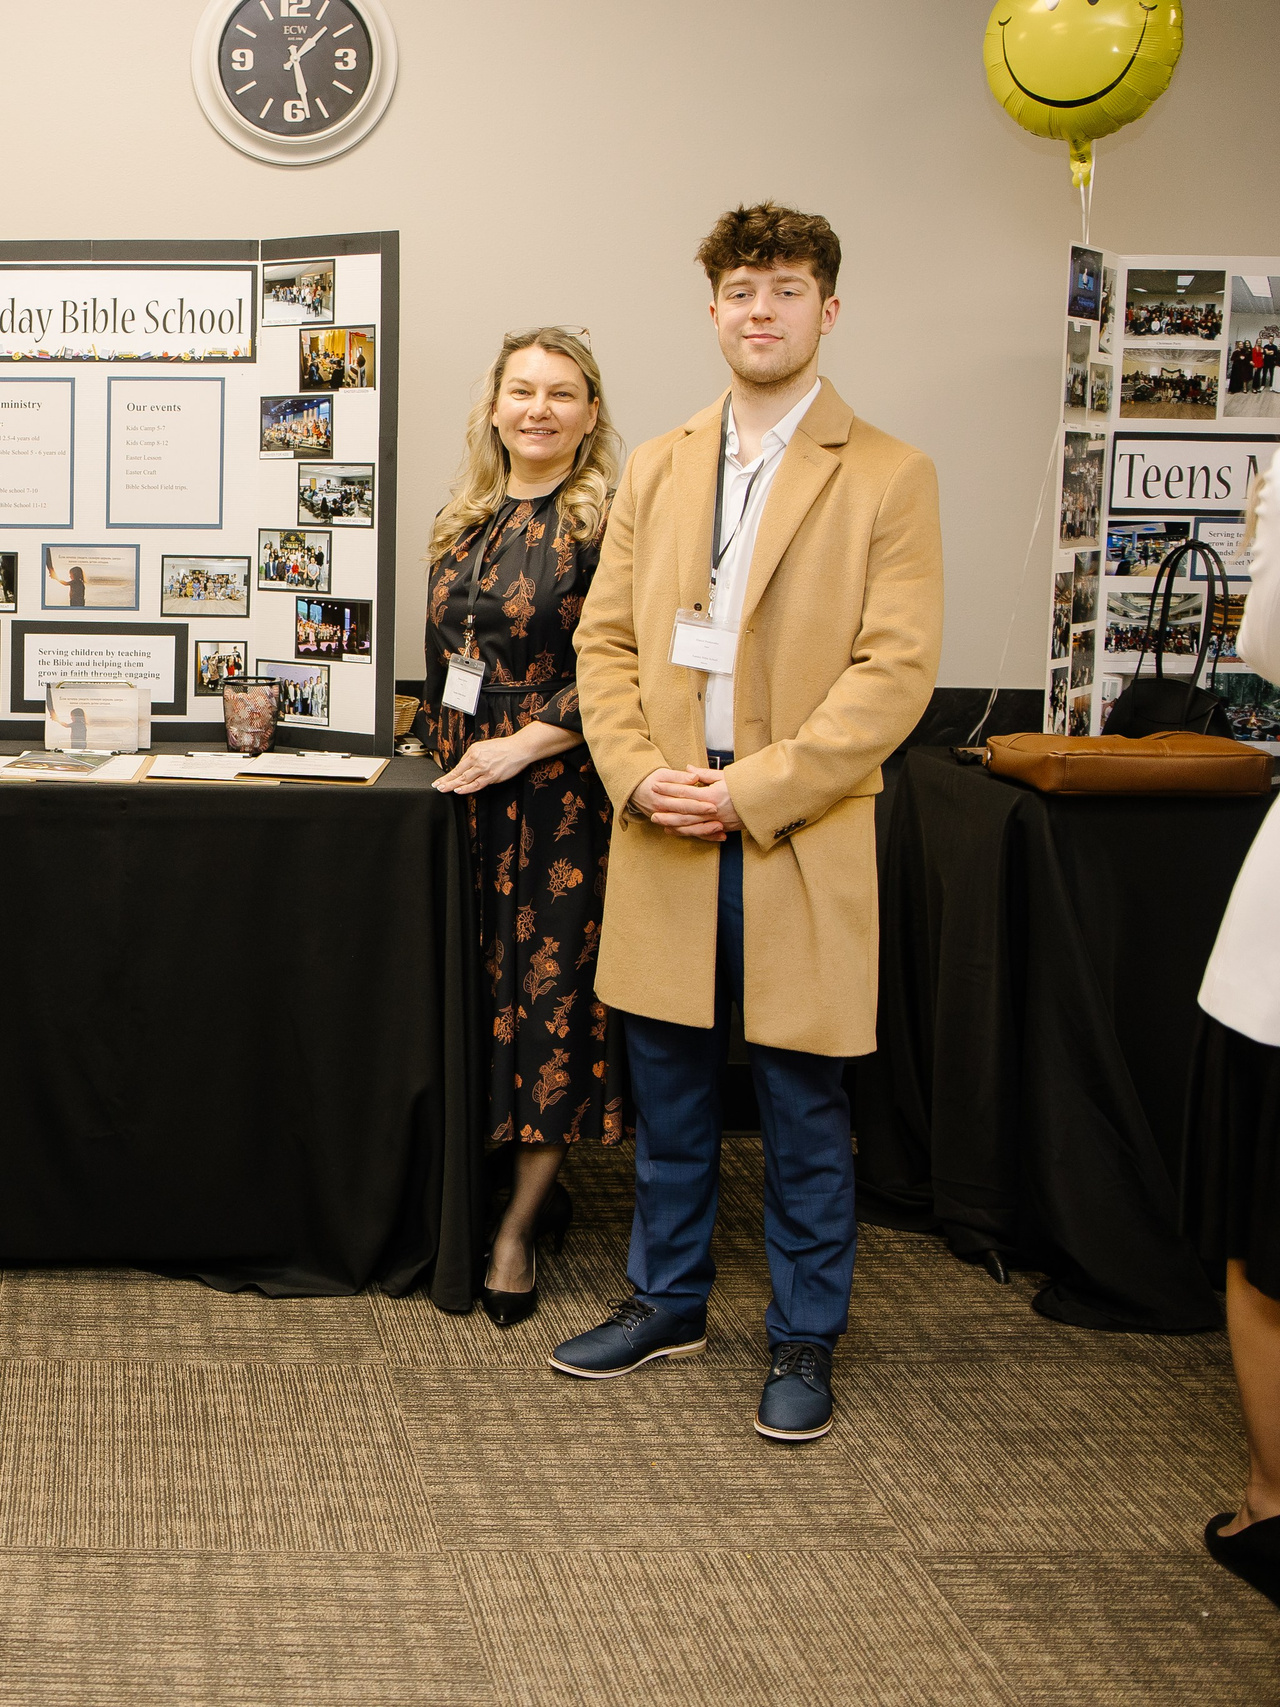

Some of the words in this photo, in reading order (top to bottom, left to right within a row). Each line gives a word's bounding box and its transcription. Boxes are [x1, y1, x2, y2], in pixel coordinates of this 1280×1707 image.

[283, 26, 308, 35] ECW
[231, 48, 254, 71] 9
[334, 48, 357, 71] 3
[283, 100, 305, 122] 6
[60, 298, 136, 335] Bible
[144, 298, 244, 335] School
[0, 400, 42, 411] ministry
[126, 402, 147, 412] Our
[150, 403, 182, 412] events
[1118, 454, 1232, 500] Teens
[1208, 531, 1235, 539] Serving
[38, 648, 69, 657] Serving
[106, 649, 114, 658] by
[118, 650, 151, 658] teaching
[93, 660, 122, 668] helping
[91, 670, 122, 679] through
